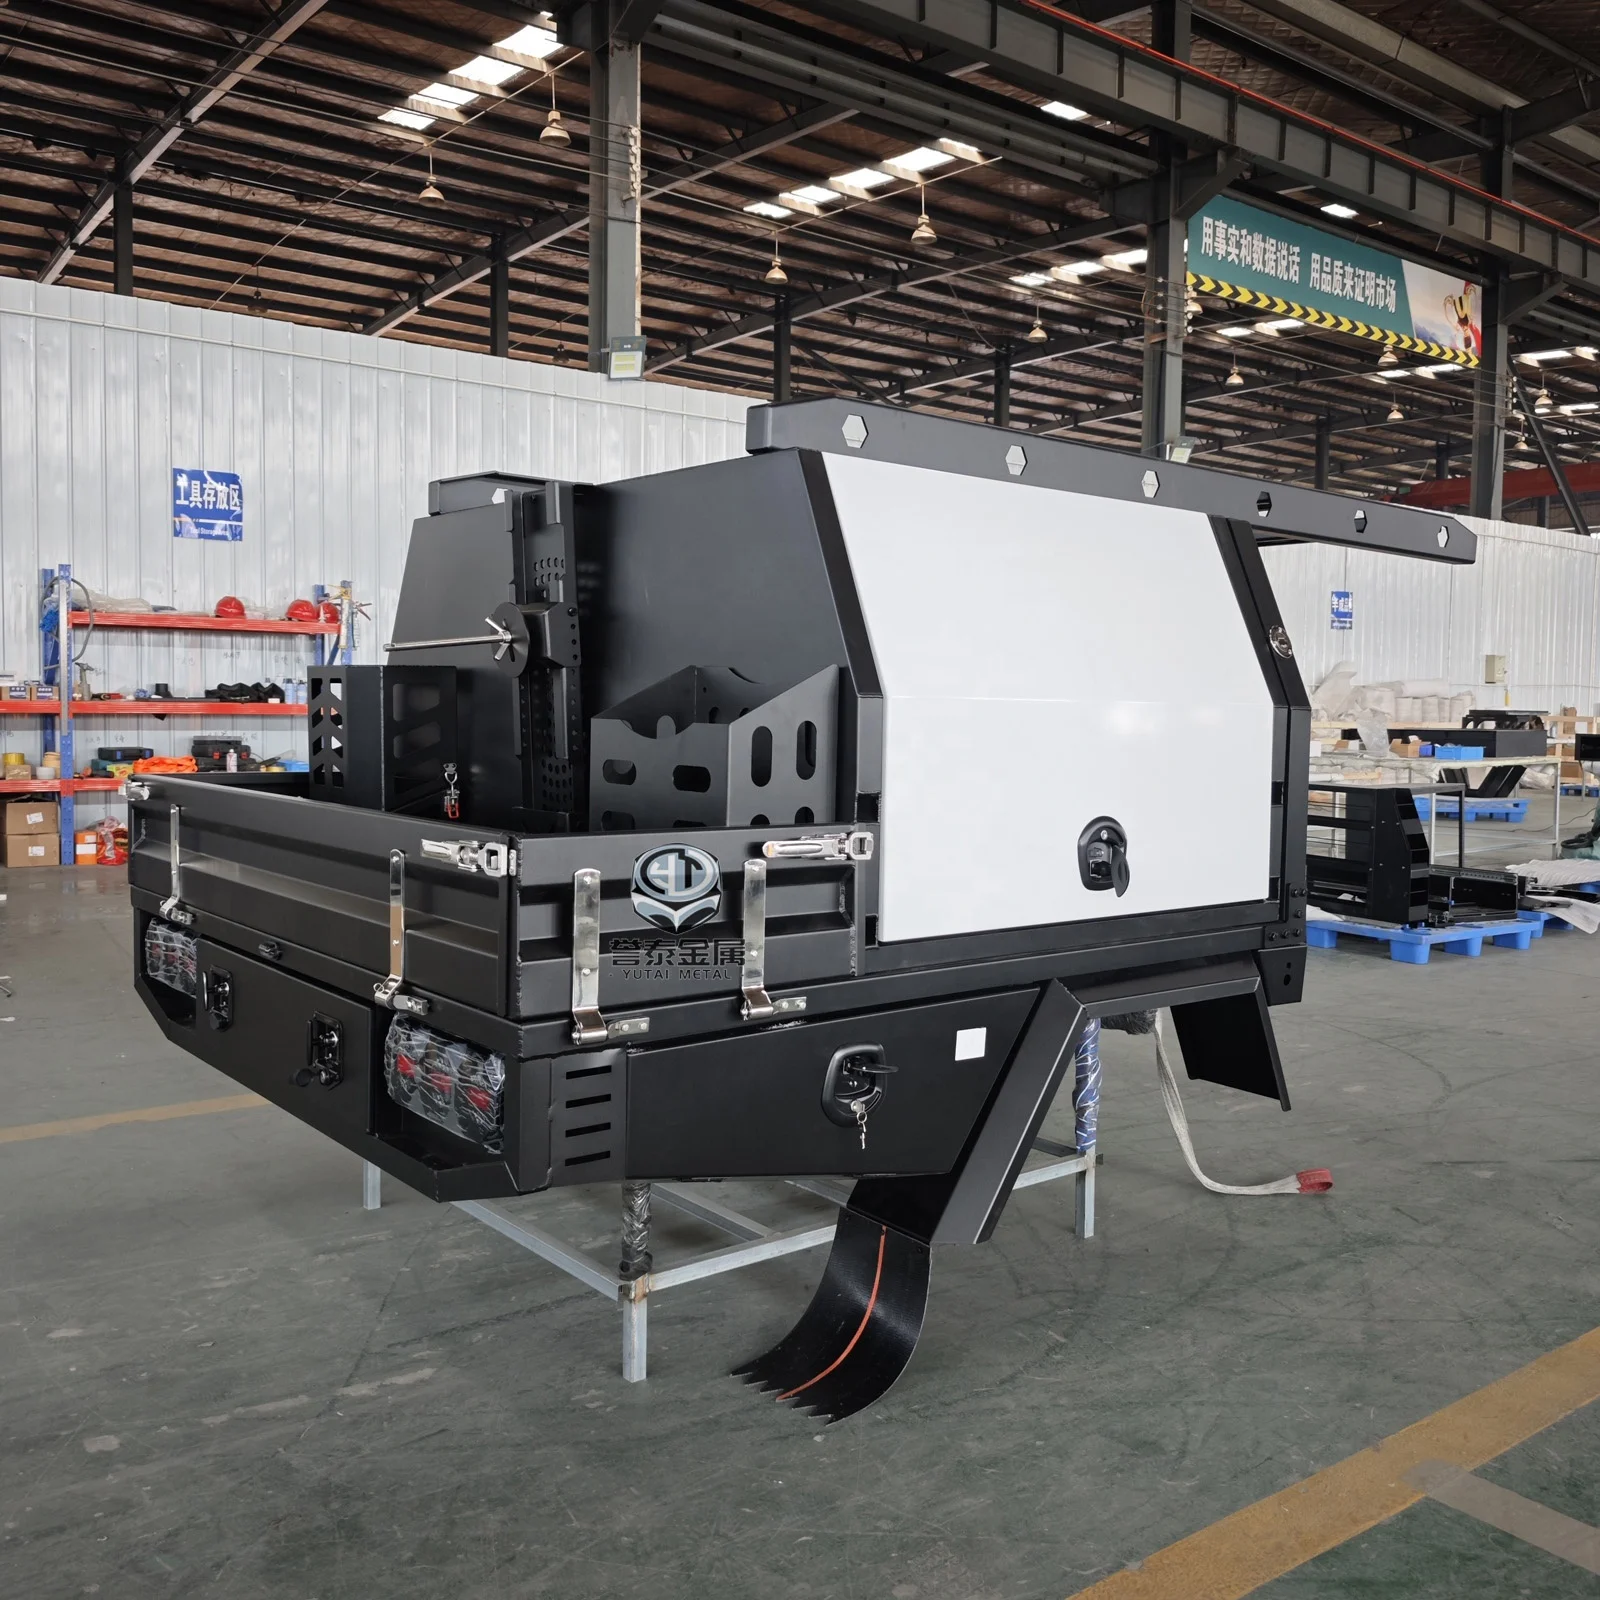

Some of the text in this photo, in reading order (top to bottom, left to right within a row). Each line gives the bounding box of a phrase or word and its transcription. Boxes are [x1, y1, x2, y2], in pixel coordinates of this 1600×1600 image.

[1201, 216, 1396, 313] 用事实和数据说话 用品质来证明市场
[176, 474, 241, 511] 工具存放区
